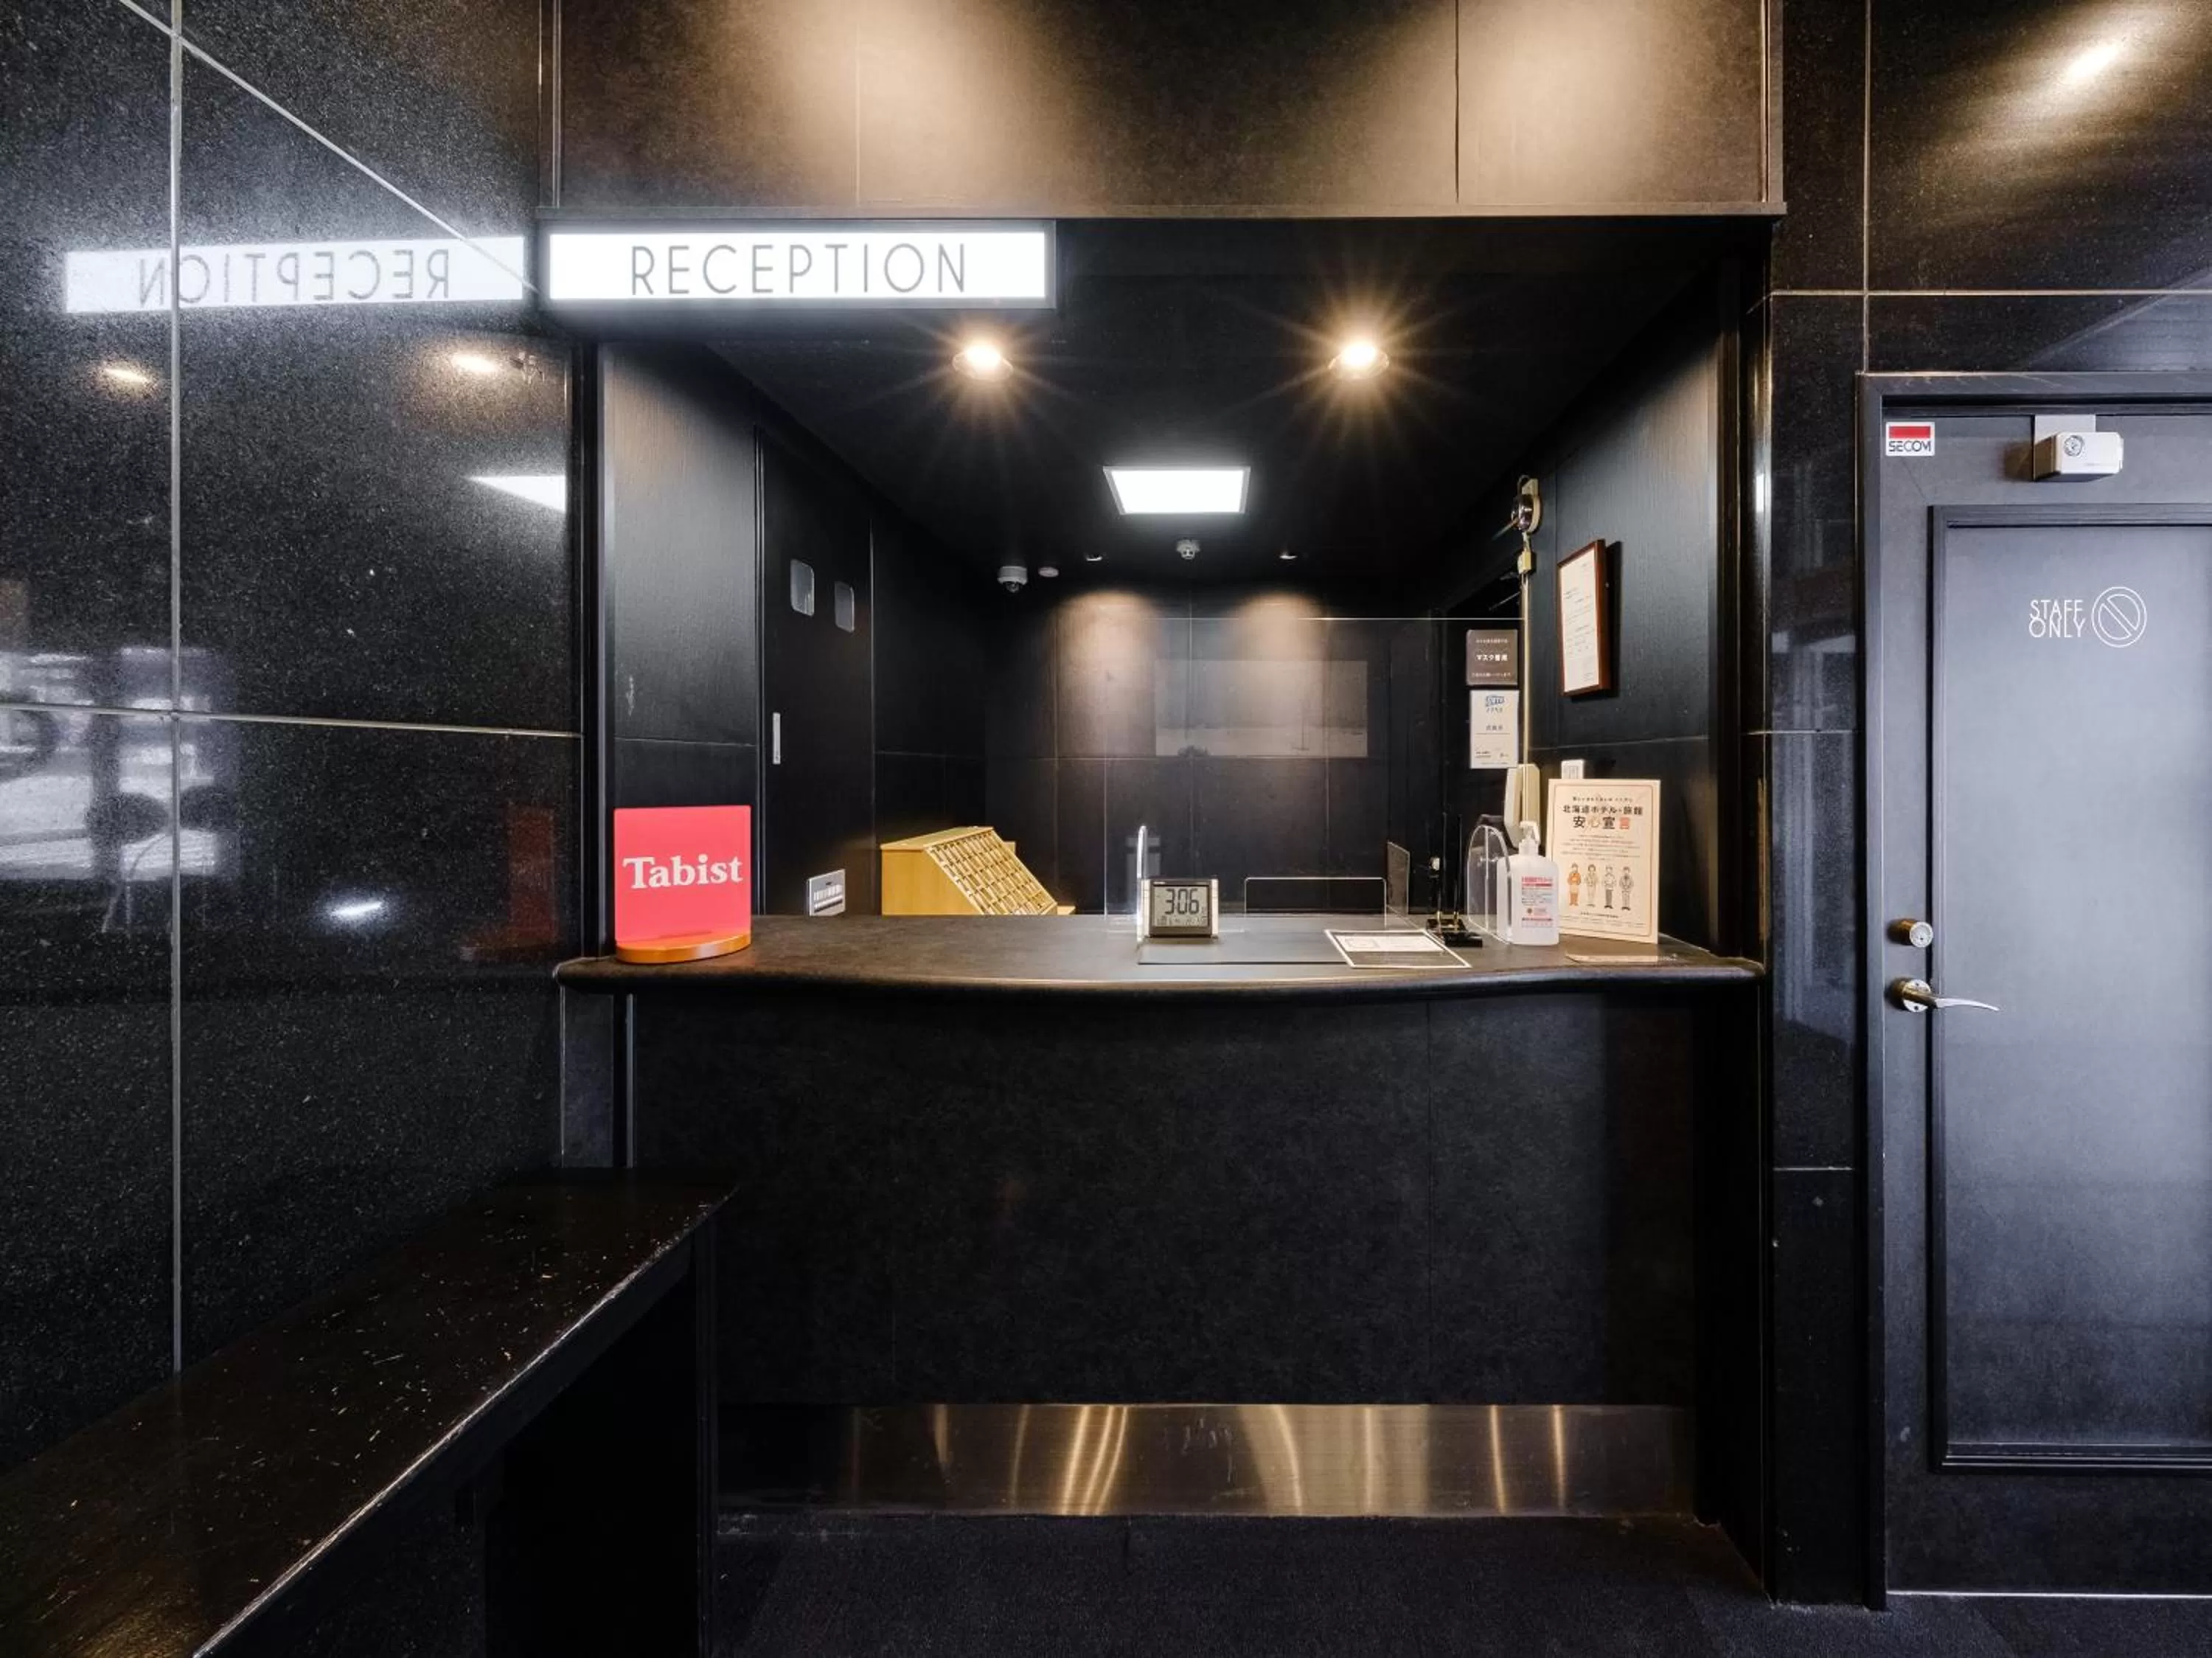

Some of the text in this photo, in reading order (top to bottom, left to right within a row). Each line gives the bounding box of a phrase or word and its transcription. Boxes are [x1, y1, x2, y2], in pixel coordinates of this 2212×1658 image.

[630, 242, 965, 296] RECEPTION
[1888, 440, 1931, 452] SECOM
[2029, 599, 2084, 620] STAFF
[2028, 617, 2086, 638] ONLY
[622, 853, 744, 889] Tabist
